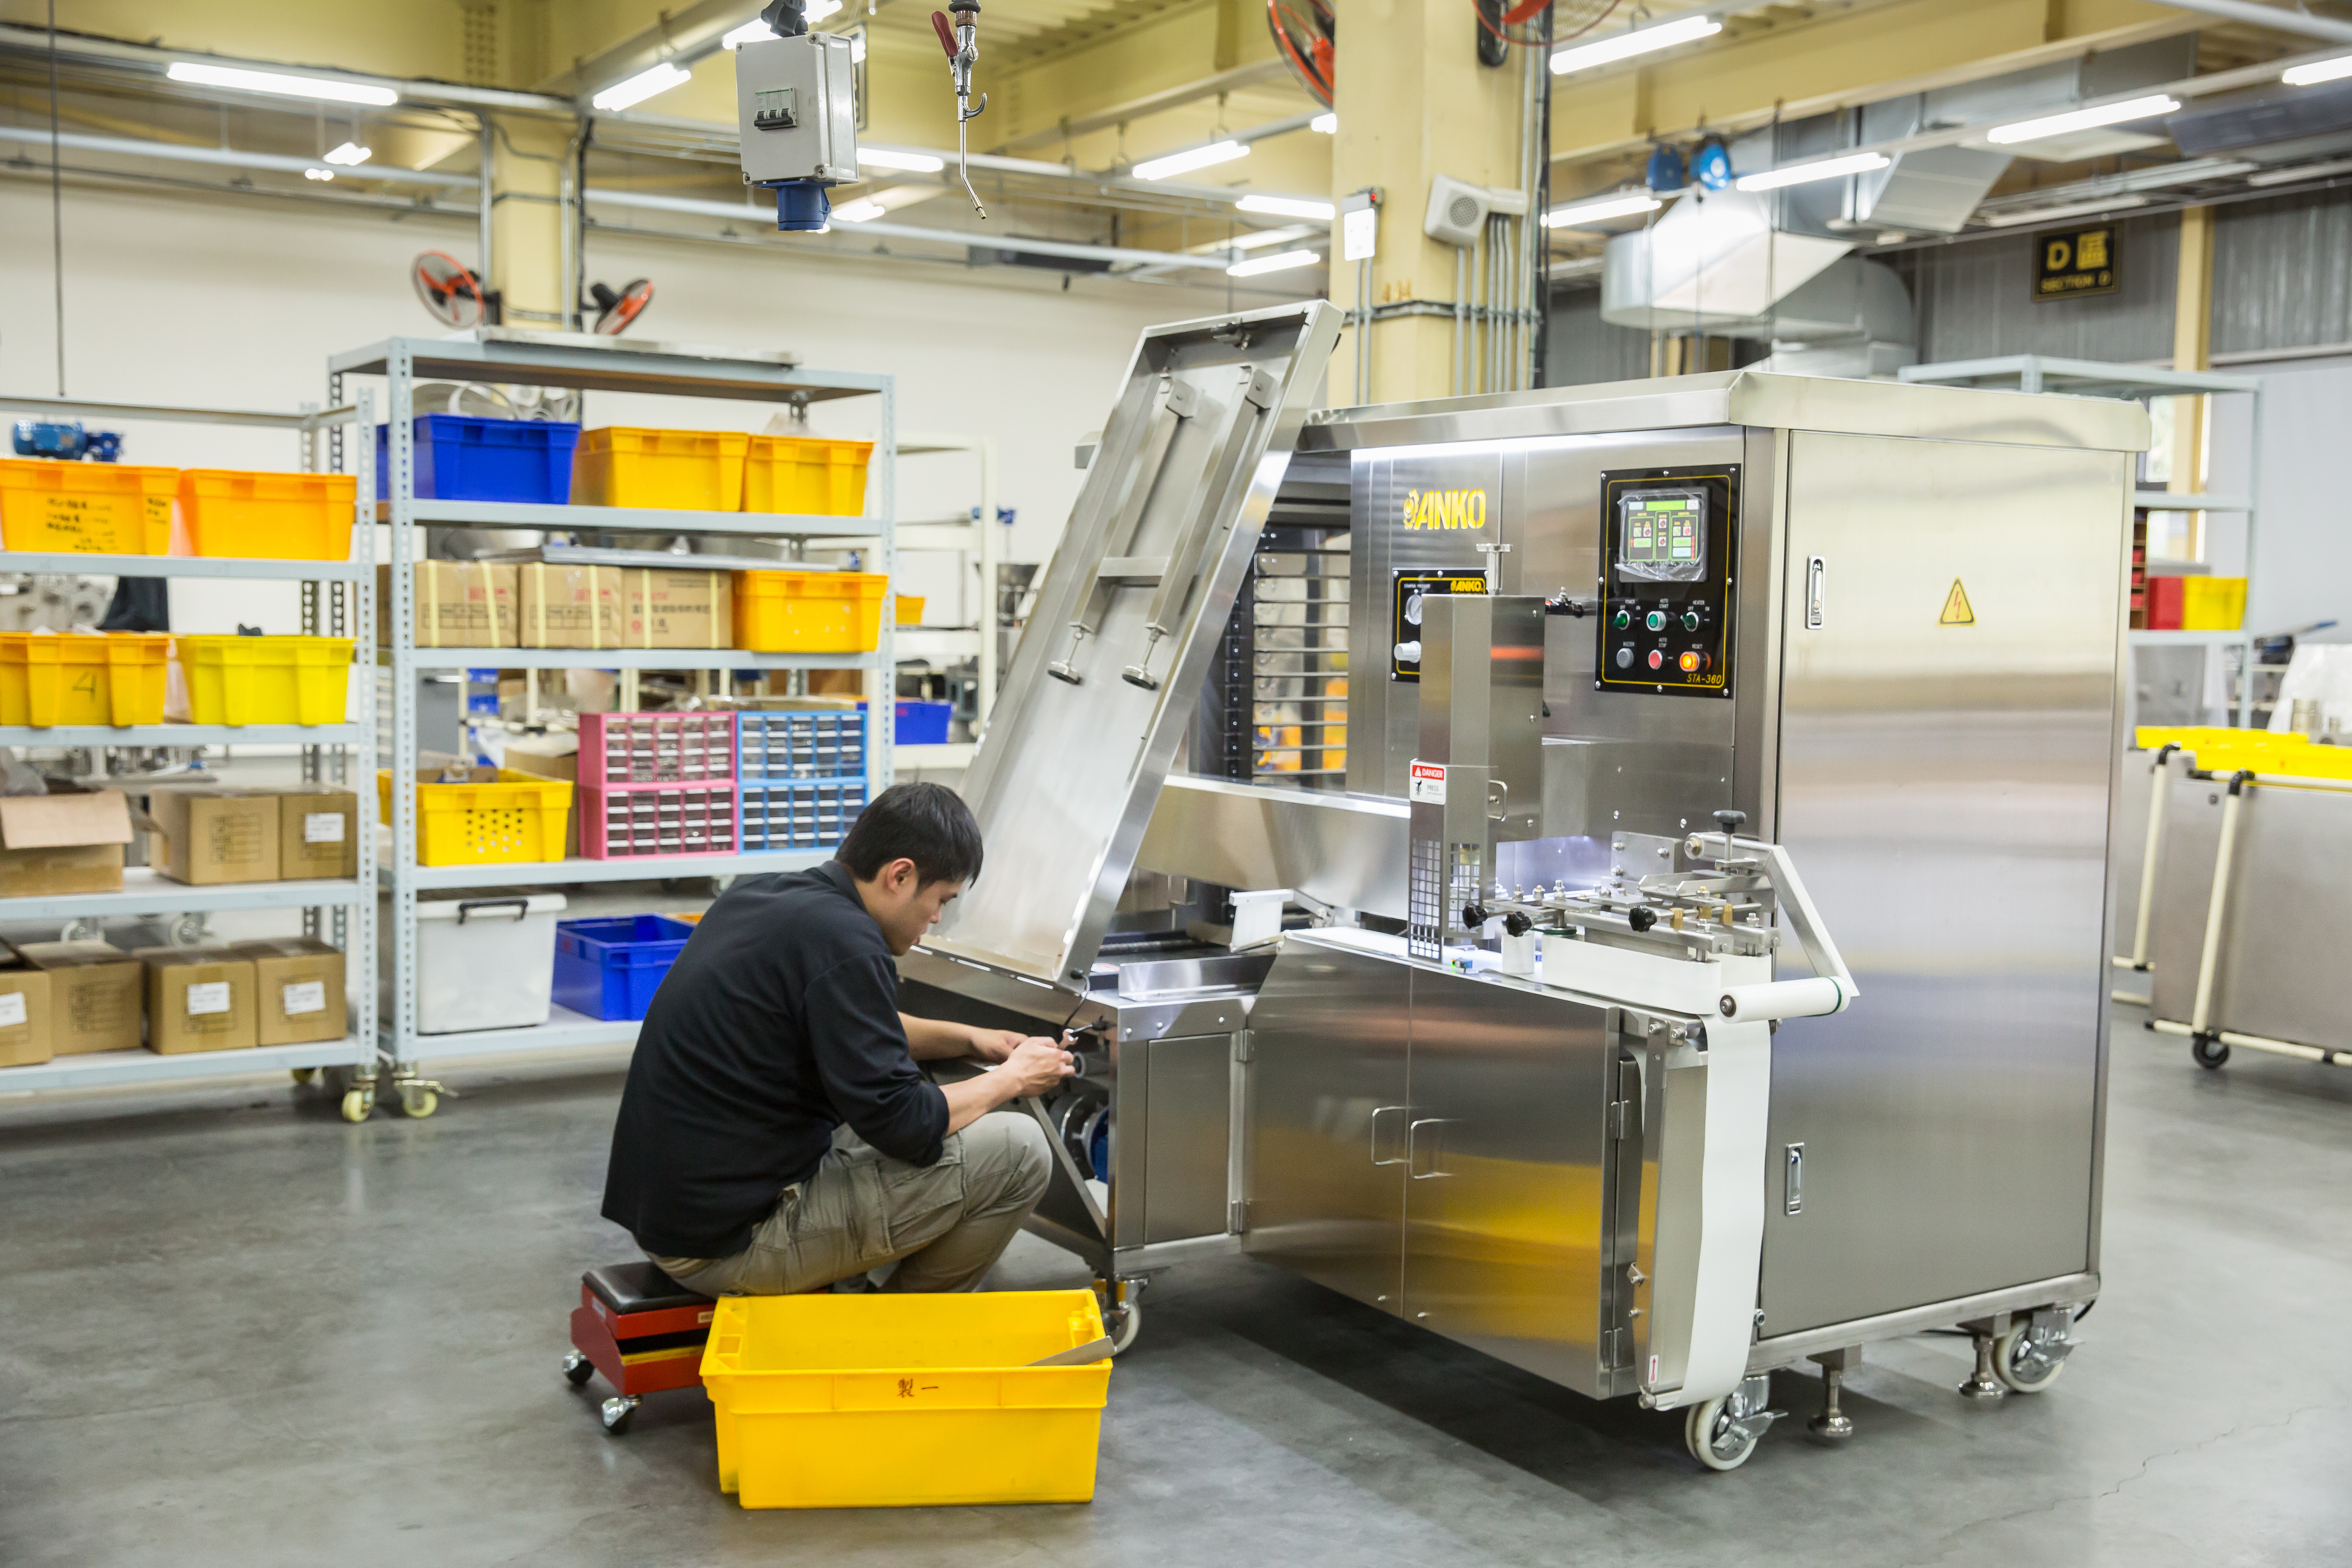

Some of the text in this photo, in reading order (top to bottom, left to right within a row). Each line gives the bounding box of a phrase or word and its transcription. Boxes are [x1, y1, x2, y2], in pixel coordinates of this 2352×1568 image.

[1413, 488, 1486, 530] ANKO
[1455, 581, 1482, 592] ANKO
[1687, 674, 1722, 684] STA-360
[71, 671, 97, 704] 4
[1422, 768, 1443, 778] DANGER
